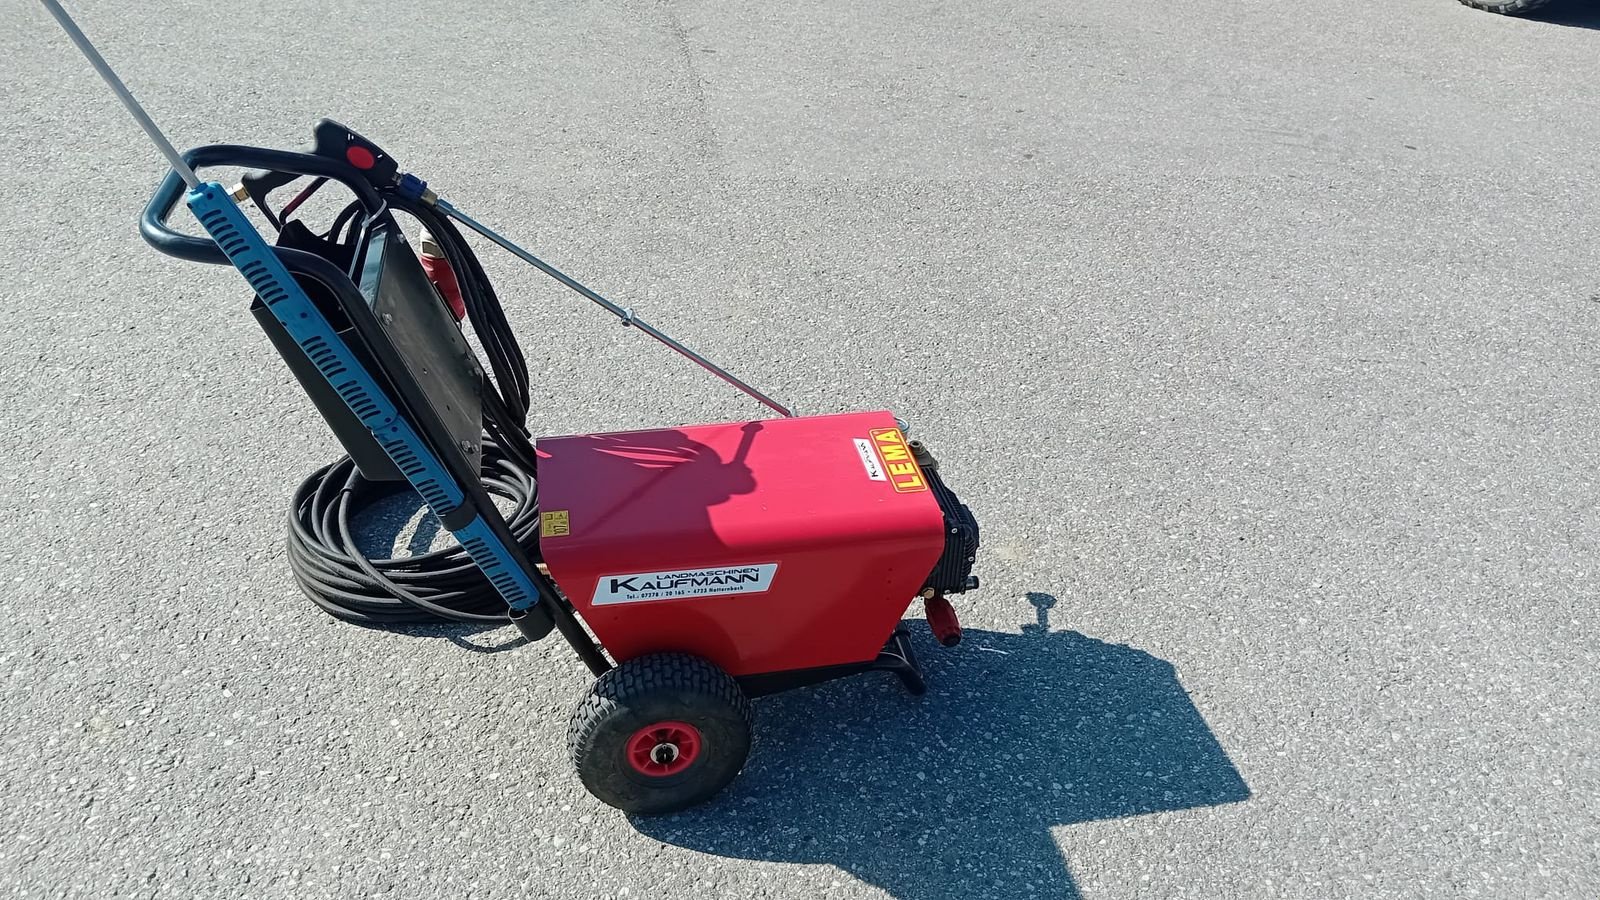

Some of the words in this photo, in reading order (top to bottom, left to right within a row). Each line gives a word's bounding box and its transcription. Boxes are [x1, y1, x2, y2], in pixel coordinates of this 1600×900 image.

[875, 430, 922, 488] LEMA
[610, 573, 759, 594] KAUFMANN
[656, 567, 760, 580] LANDMASCHINEN
